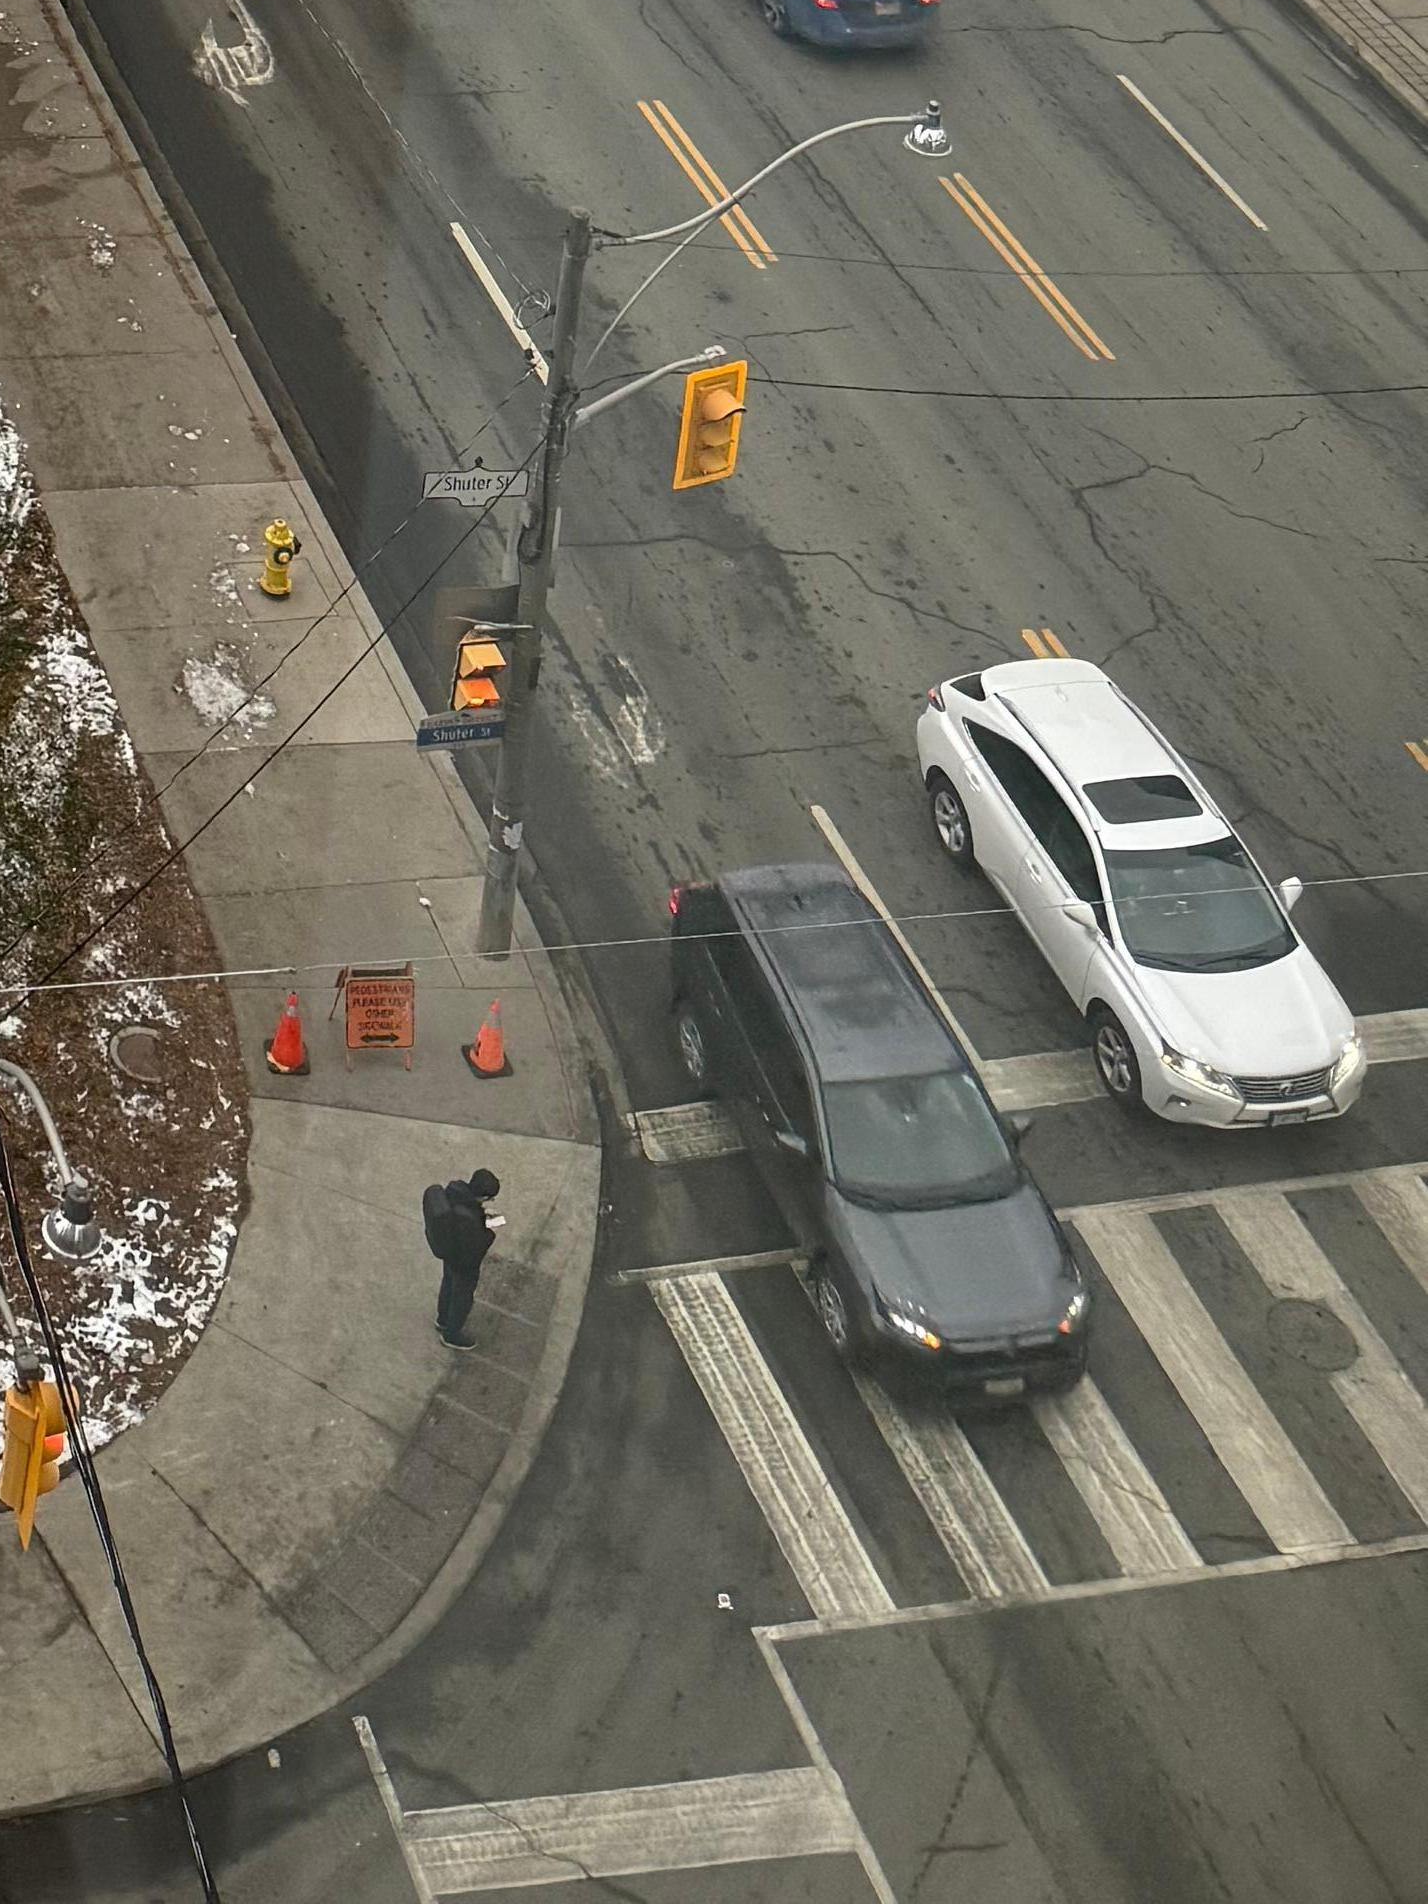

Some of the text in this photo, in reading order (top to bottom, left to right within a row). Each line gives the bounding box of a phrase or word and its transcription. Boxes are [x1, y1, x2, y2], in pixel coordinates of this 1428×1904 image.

[444, 475, 510, 491] Shuter St
[432, 727, 491, 742] Shuter St
